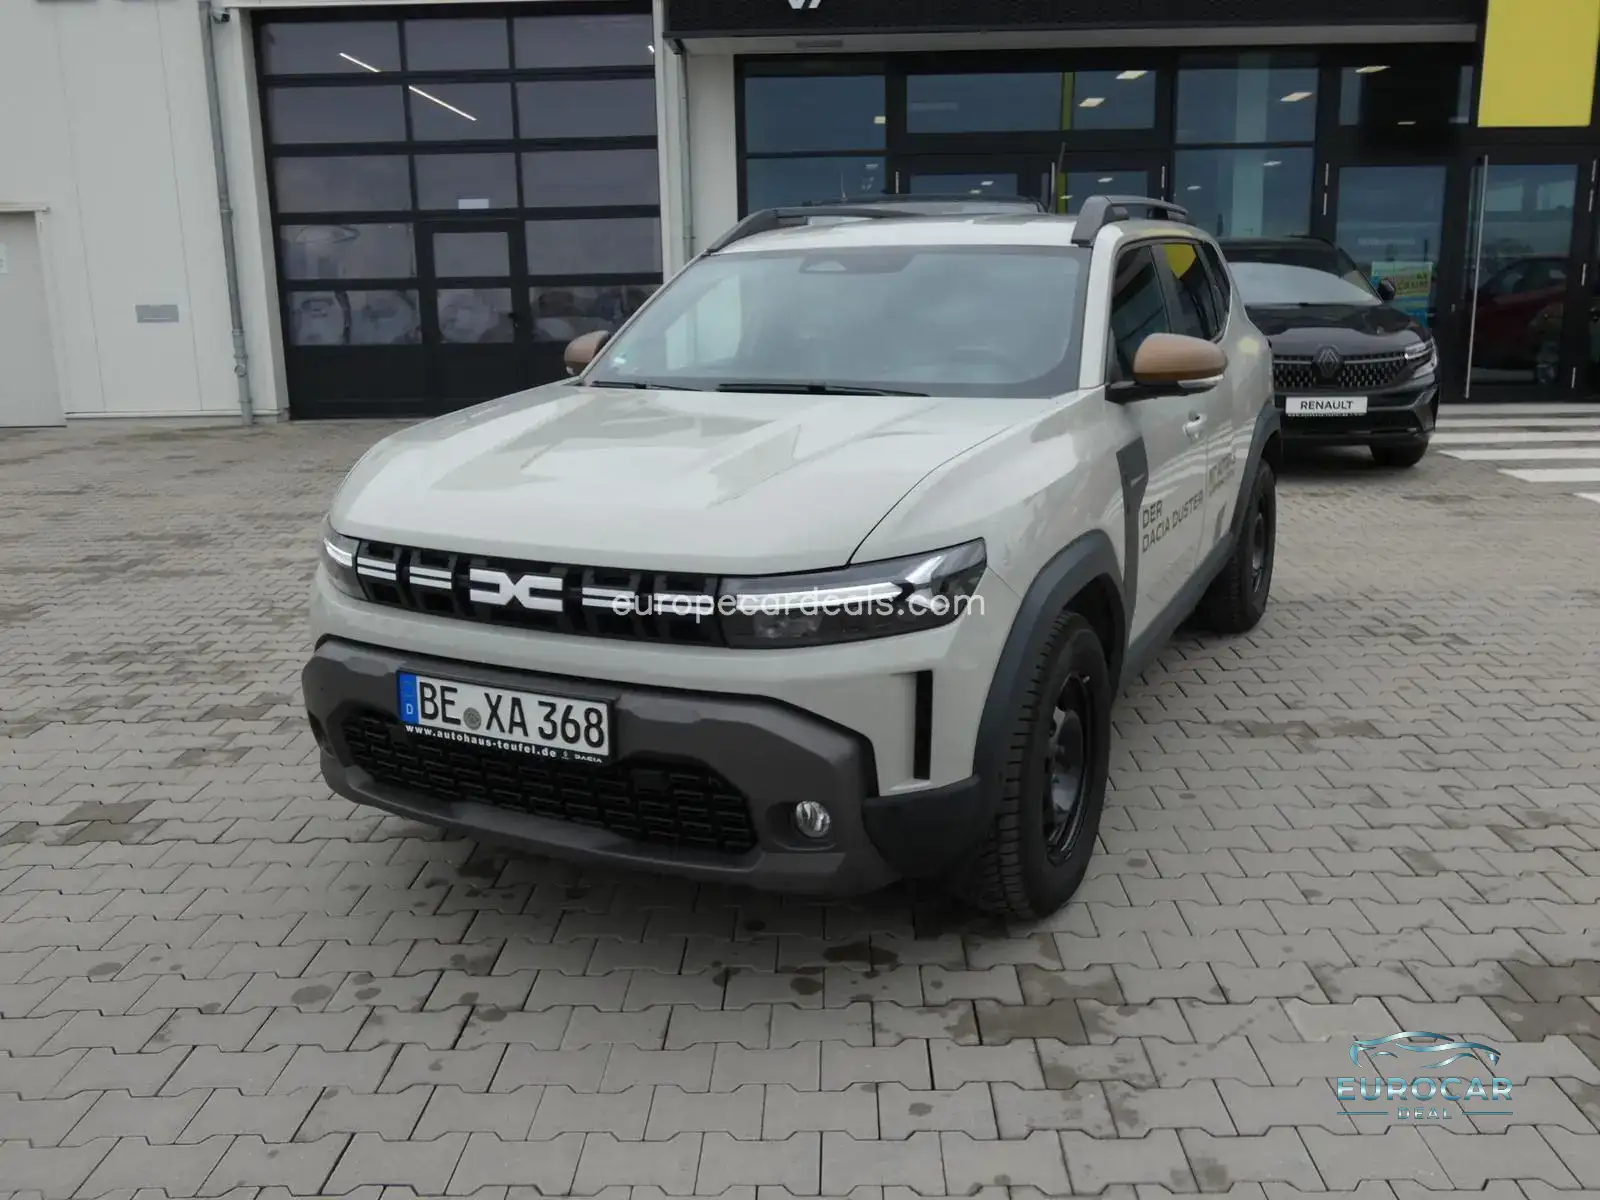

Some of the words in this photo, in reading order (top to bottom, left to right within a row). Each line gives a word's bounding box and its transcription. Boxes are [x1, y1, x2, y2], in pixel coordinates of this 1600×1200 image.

[1300, 400, 1353, 410] RENAULT
[1142, 500, 1163, 529] DER
[1142, 515, 1171, 553] DACIA
[1172, 489, 1204, 529] DUSTER
[406, 703, 414, 715] D
[419, 681, 461, 725] BE
[484, 692, 528, 737] XA
[537, 700, 605, 748] 368
[405, 724, 556, 758] www.autohaus-teufel.de
